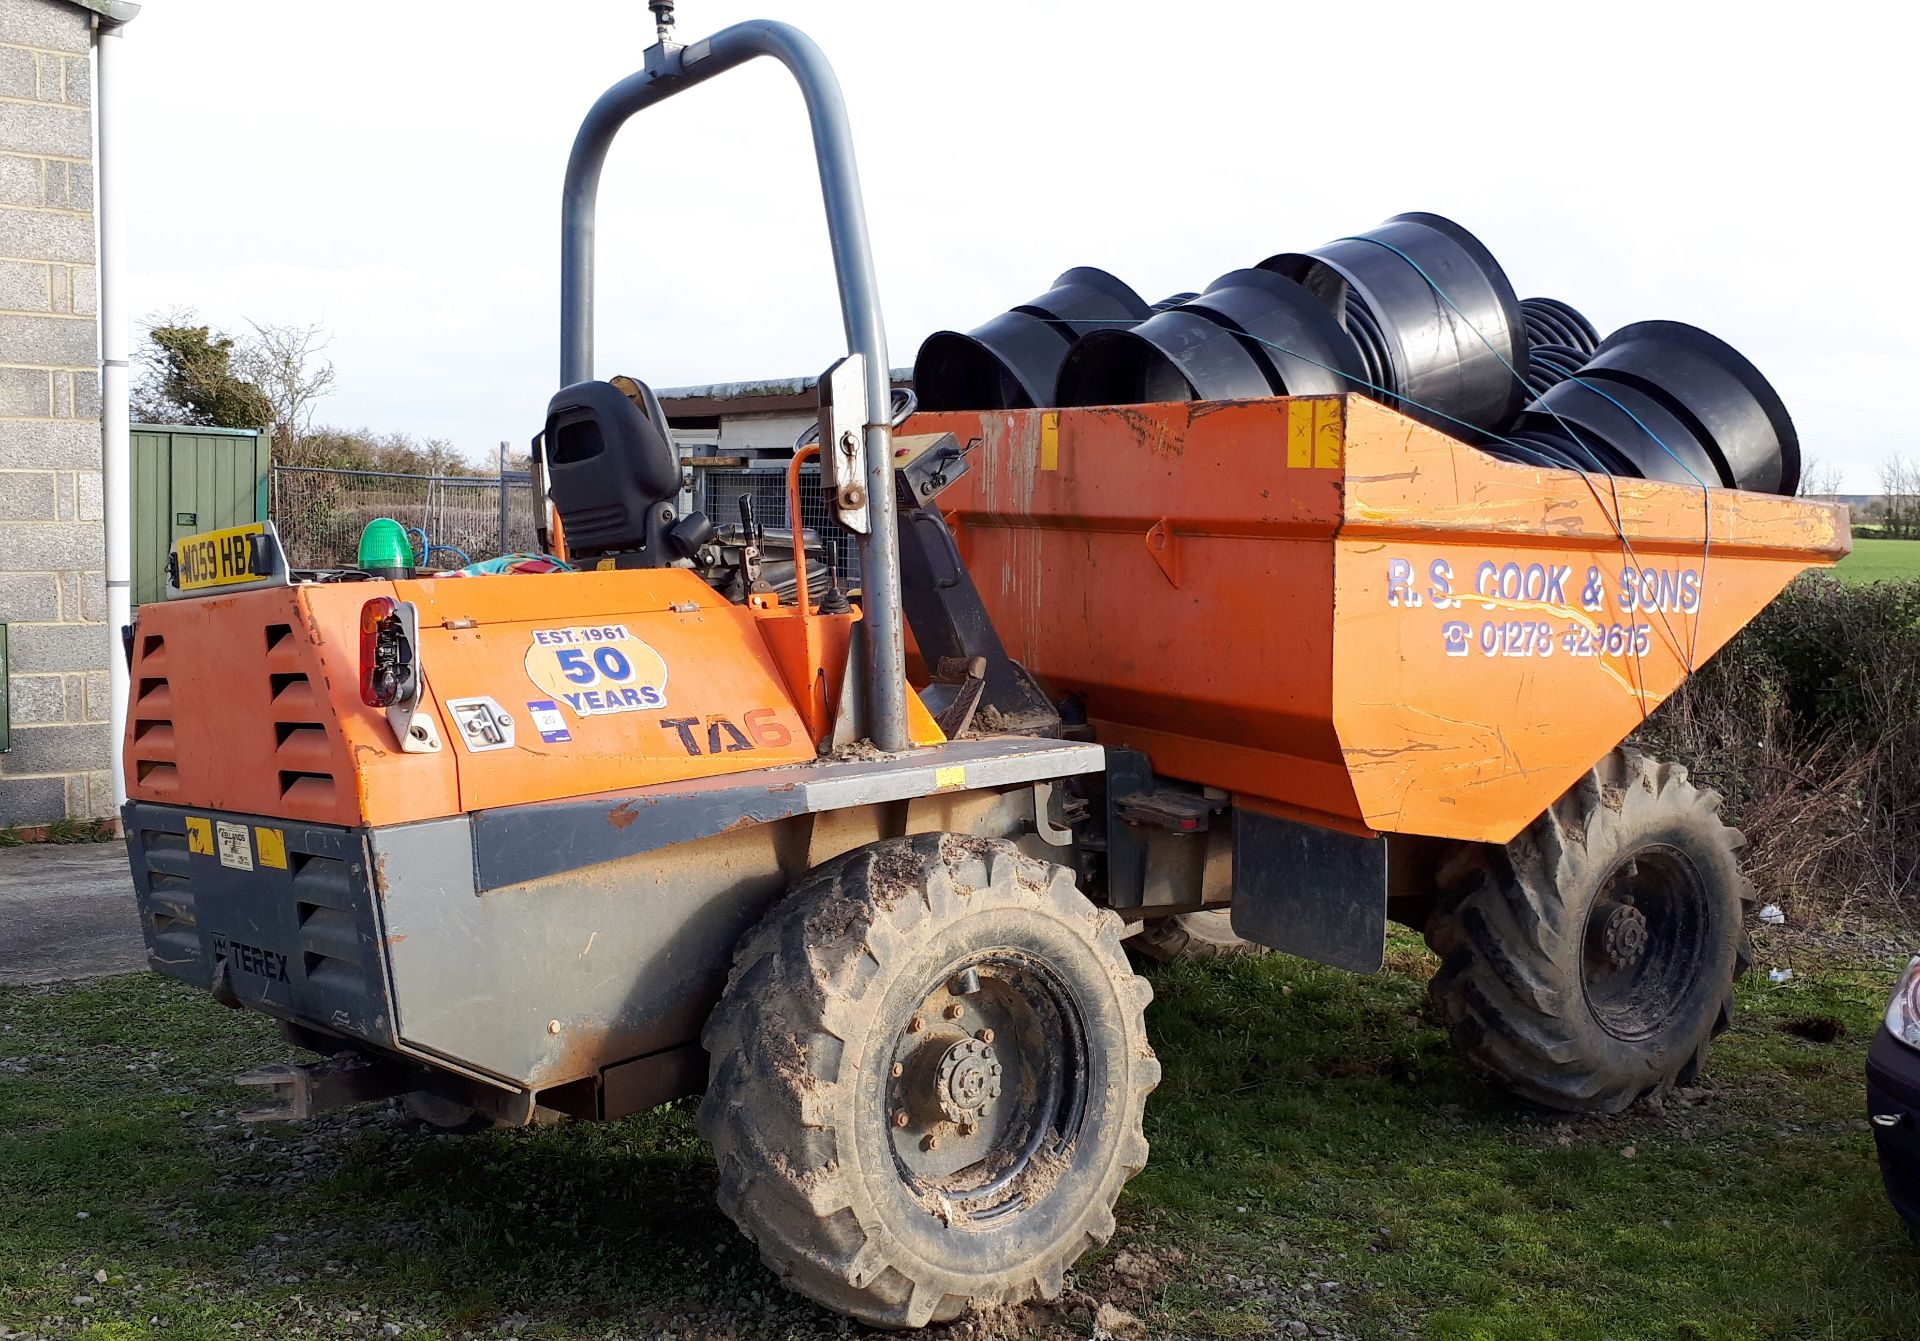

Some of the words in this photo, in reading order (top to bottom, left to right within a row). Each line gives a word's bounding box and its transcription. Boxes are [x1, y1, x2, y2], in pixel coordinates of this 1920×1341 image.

[1388, 558, 1421, 606] R.
[1428, 559, 1461, 608] S.
[1475, 560, 1571, 610] COOK
[1582, 566, 1604, 611] &
[1618, 567, 1703, 614] SONS
[535, 630, 579, 645] EST.
[581, 627, 626, 641] 1961
[1480, 620, 1552, 657] 01278
[556, 646, 633, 685] 50
[563, 686, 661, 711] YEARS
[659, 708, 792, 756] TA6
[229, 941, 291, 984] TEREX
